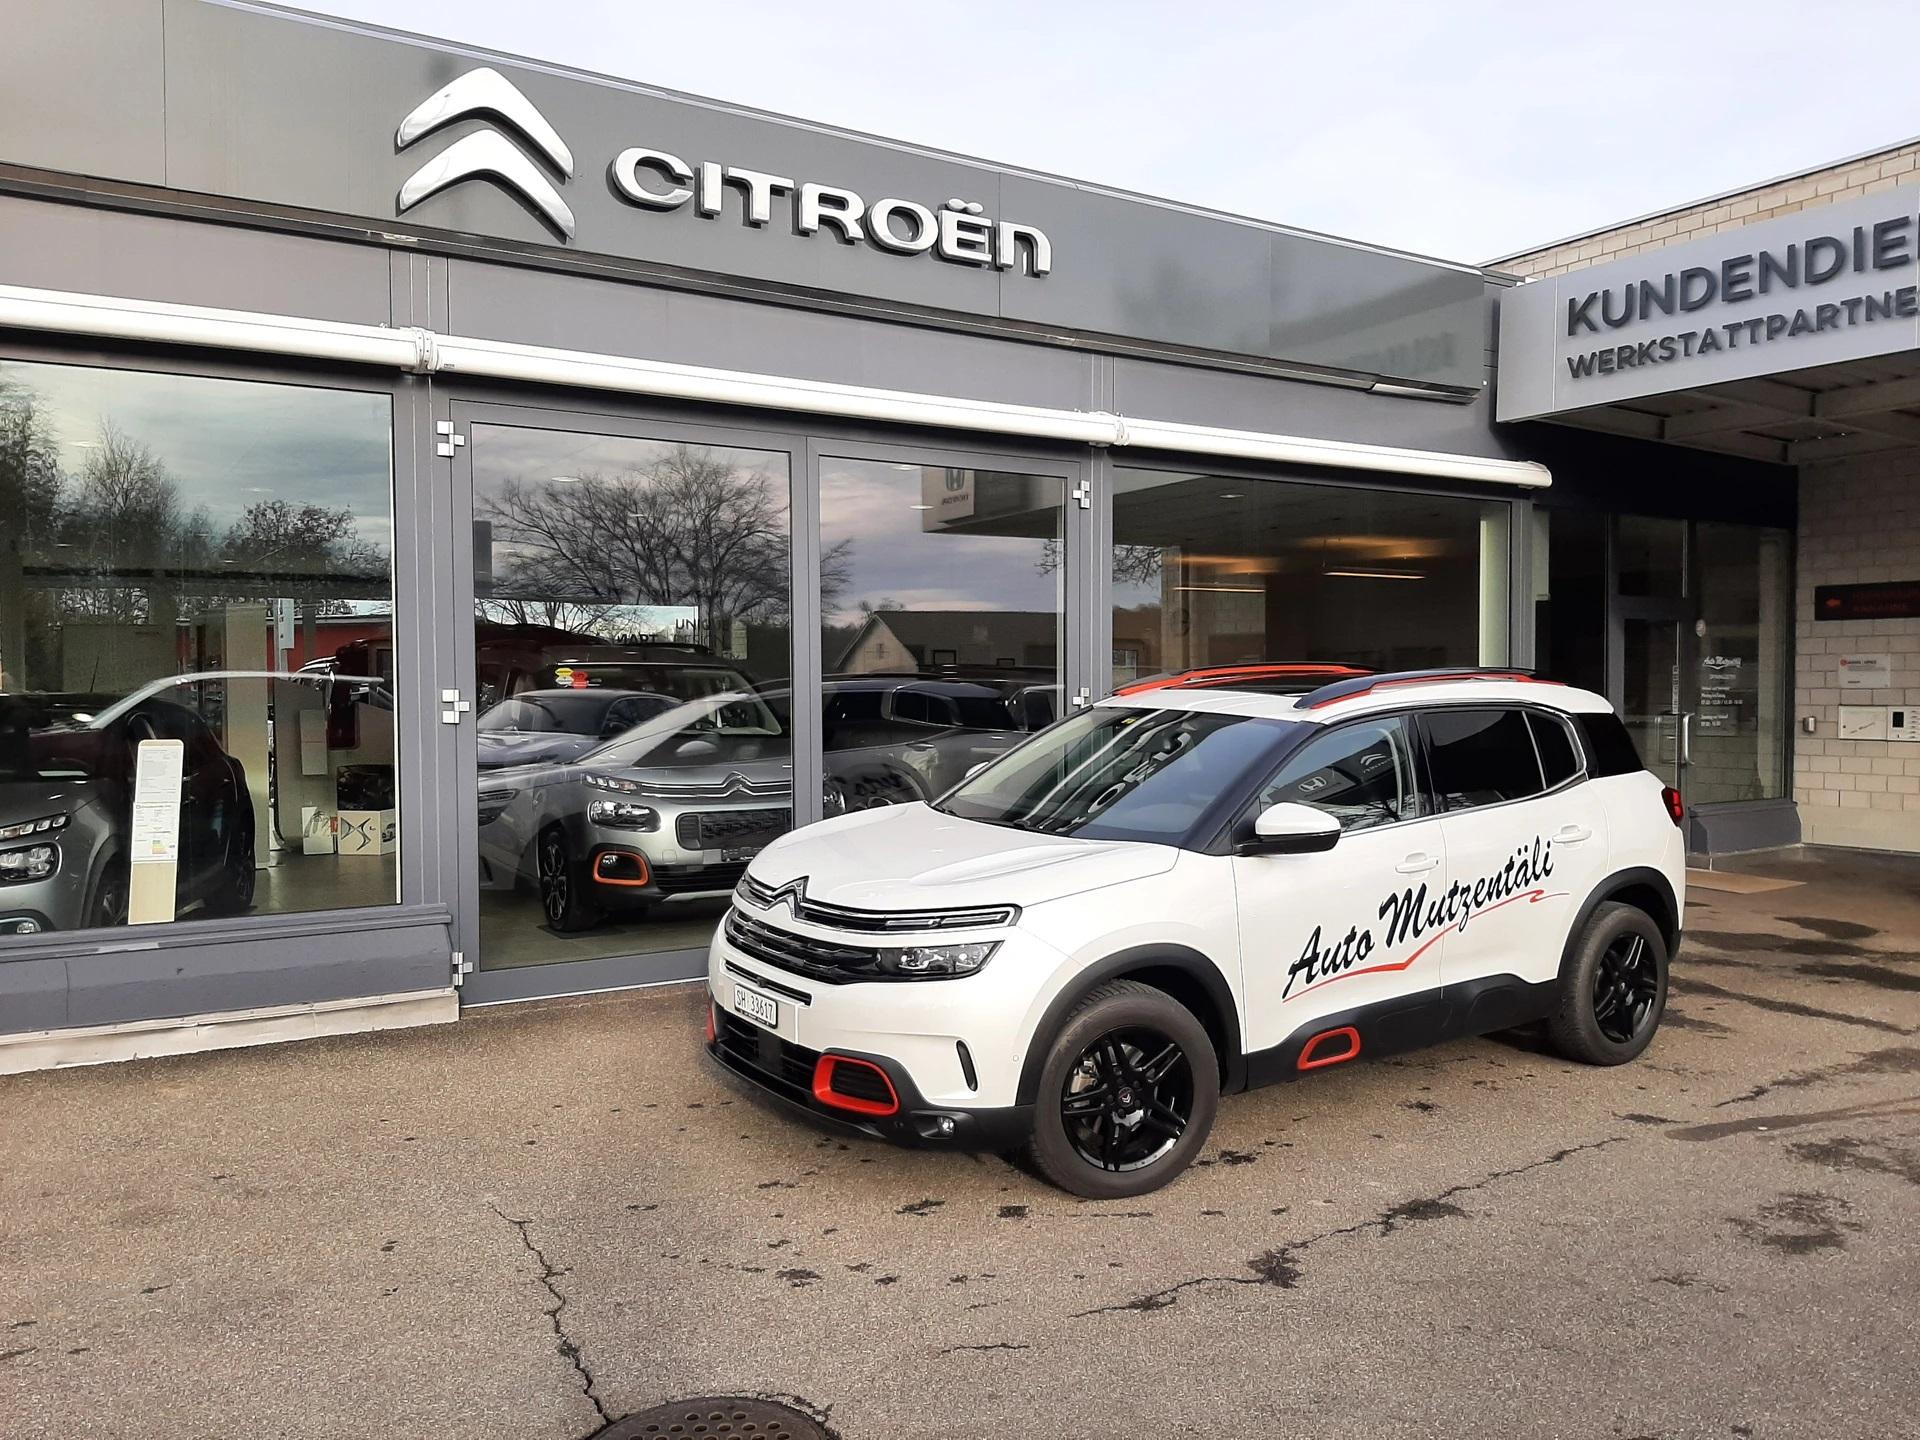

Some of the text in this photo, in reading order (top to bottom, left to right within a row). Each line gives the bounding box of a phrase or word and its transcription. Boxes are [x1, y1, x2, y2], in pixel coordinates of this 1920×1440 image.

[1567, 212, 1920, 337] KUNDENDIE
[1282, 834, 1554, 1000] Auto Mutzentäli
[736, 990, 746, 1009] SH
[750, 994, 773, 1021] 33617
